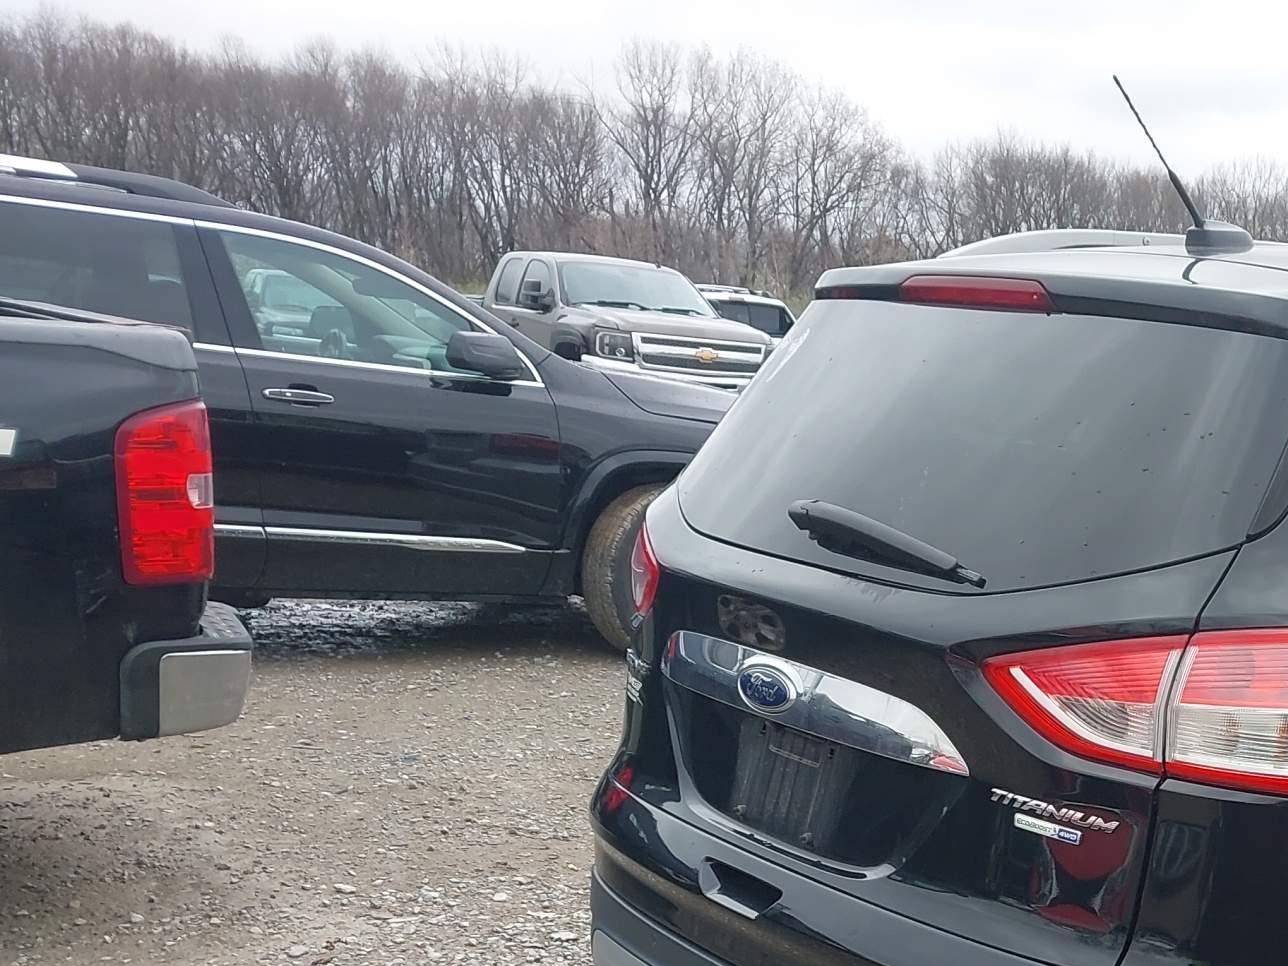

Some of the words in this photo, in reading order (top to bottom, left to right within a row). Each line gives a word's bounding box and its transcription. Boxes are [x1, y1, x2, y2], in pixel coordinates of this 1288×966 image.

[747, 672, 778, 701] Ford
[991, 788, 1120, 833] TITANIUM
[1058, 831, 1077, 841] 4WD
